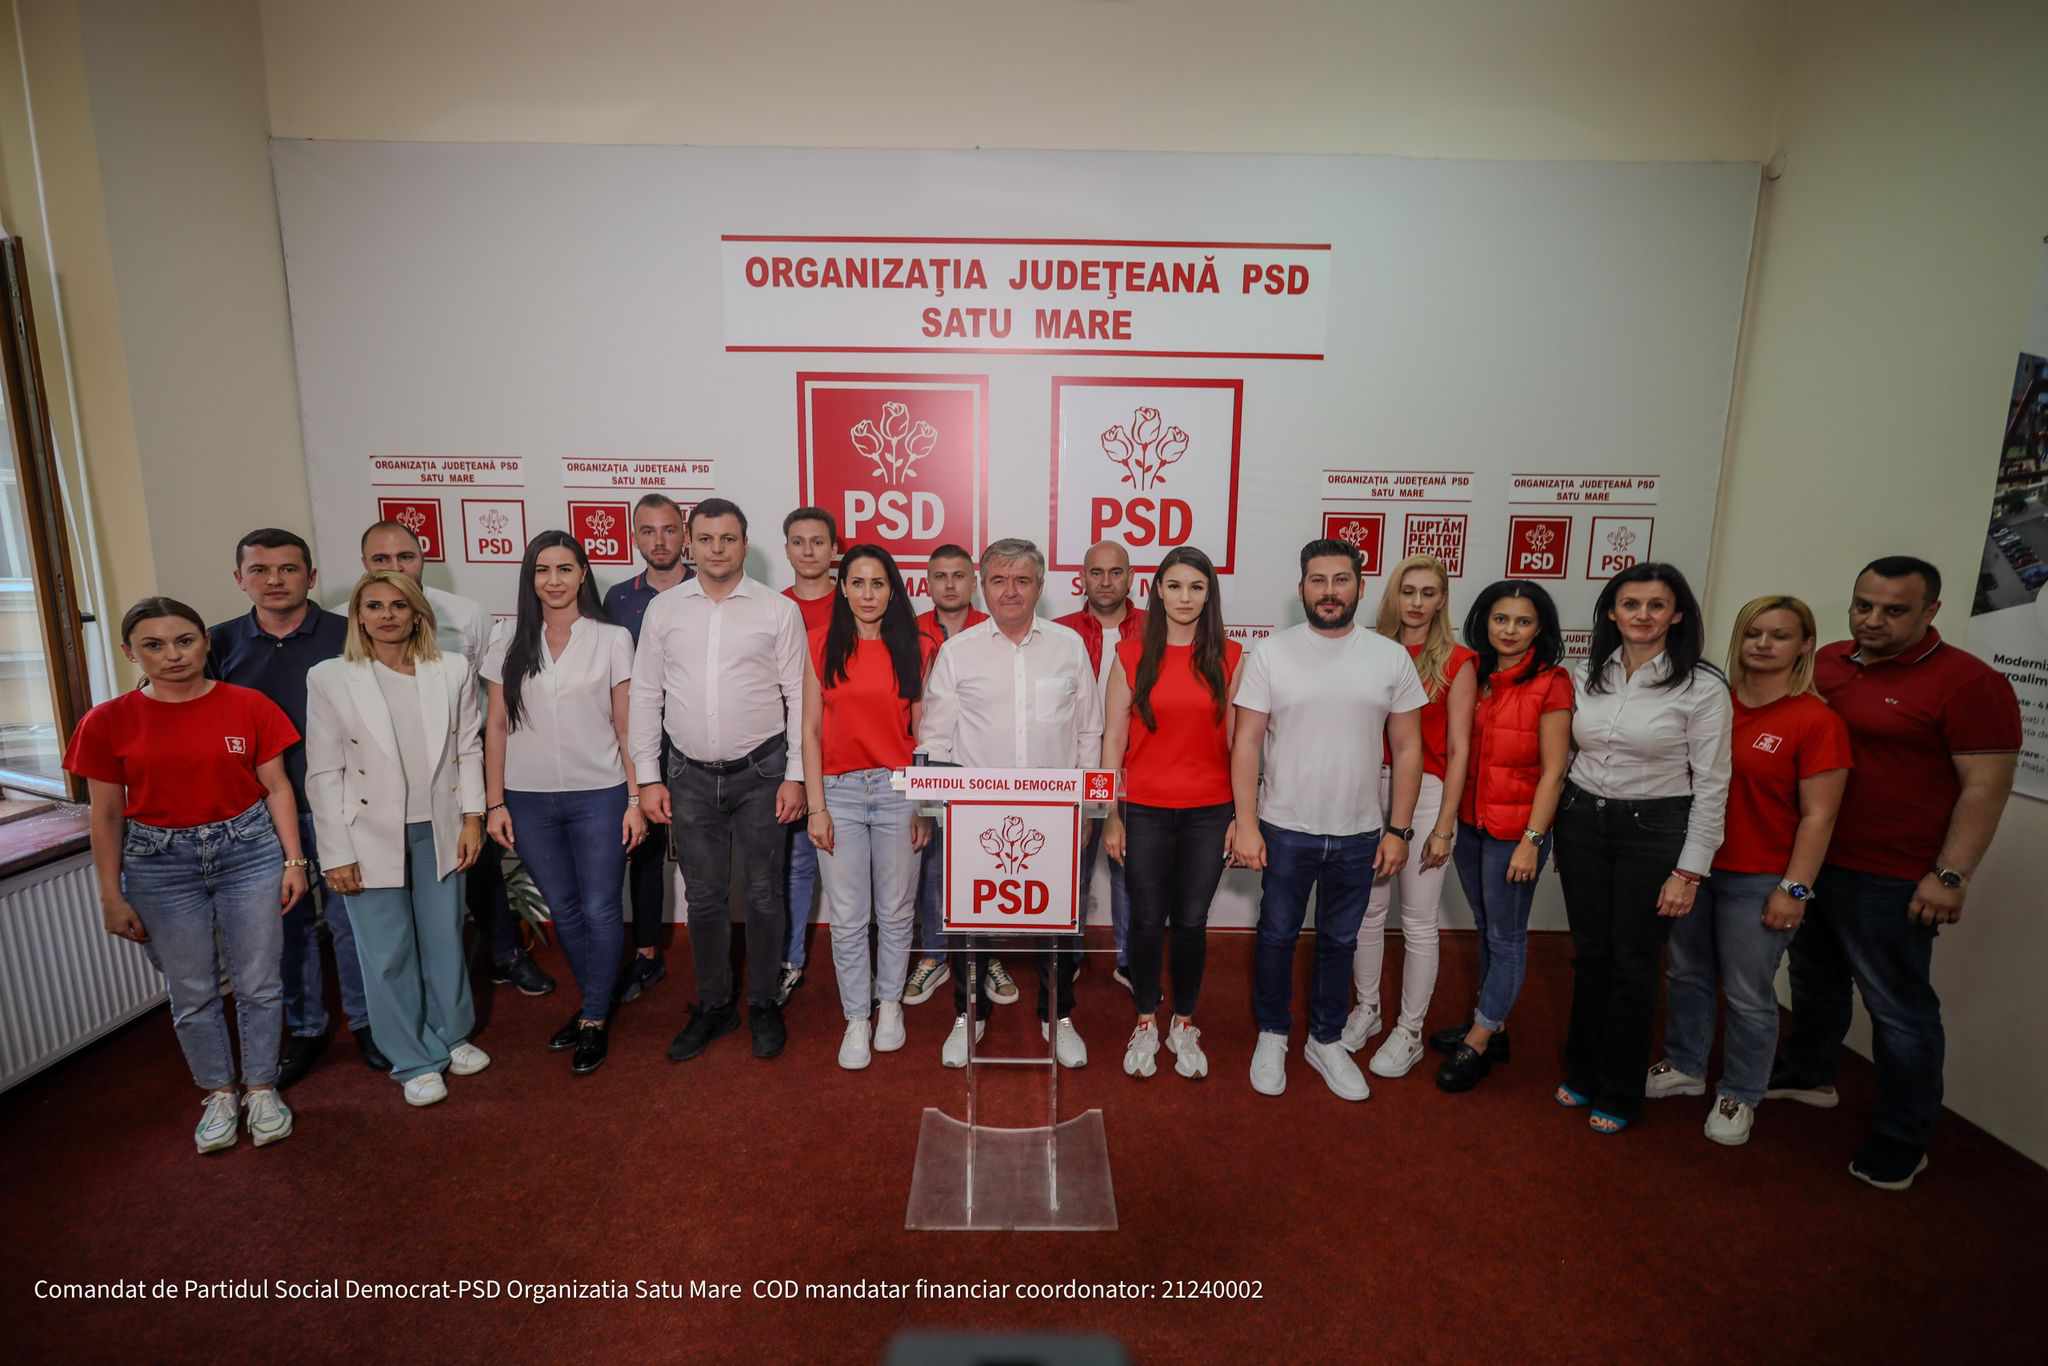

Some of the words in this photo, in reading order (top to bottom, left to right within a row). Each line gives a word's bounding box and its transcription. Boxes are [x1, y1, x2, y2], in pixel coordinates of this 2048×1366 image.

[745, 256, 988, 297] ORGANIZAŢIA
[1009, 255, 1220, 299] JUDEŢEANĂ
[1242, 263, 1310, 295] PSD
[921, 307, 1012, 338] SATU
[1035, 308, 1133, 340] MARE
[501, 461, 519, 470] PSD
[692, 464, 710, 473] PSD
[420, 473, 444, 483] SATU
[449, 474, 475, 483] MARE
[612, 476, 636, 485] SATU
[640, 477, 666, 486] MARE
[1451, 477, 1470, 486] PSD
[1637, 480, 1655, 489] PSD
[1371, 488, 1395, 497] SATU
[1399, 488, 1425, 498] MARE
[1556, 492, 1580, 501] SATU
[1584, 492, 1611, 502] MARE
[844, 490, 945, 540] PSD
[1090, 497, 1193, 547] PSD
[1409, 518, 1463, 533] LUPTĂM
[1408, 533, 1461, 546] PENTRU
[478, 538, 513, 554] PSD
[584, 538, 619, 556] PSD
[1520, 552, 1554, 570] PSD
[1252, 630, 1270, 638] PSD
[1568, 646, 1592, 656] MAR
[910, 777, 966, 790] PARTIDUL
[968, 778, 1011, 791] SOCIAL
[1014, 779, 1078, 792] DEMOCRAT
[1089, 789, 1109, 799] PSD
[973, 879, 1050, 915] PSD
